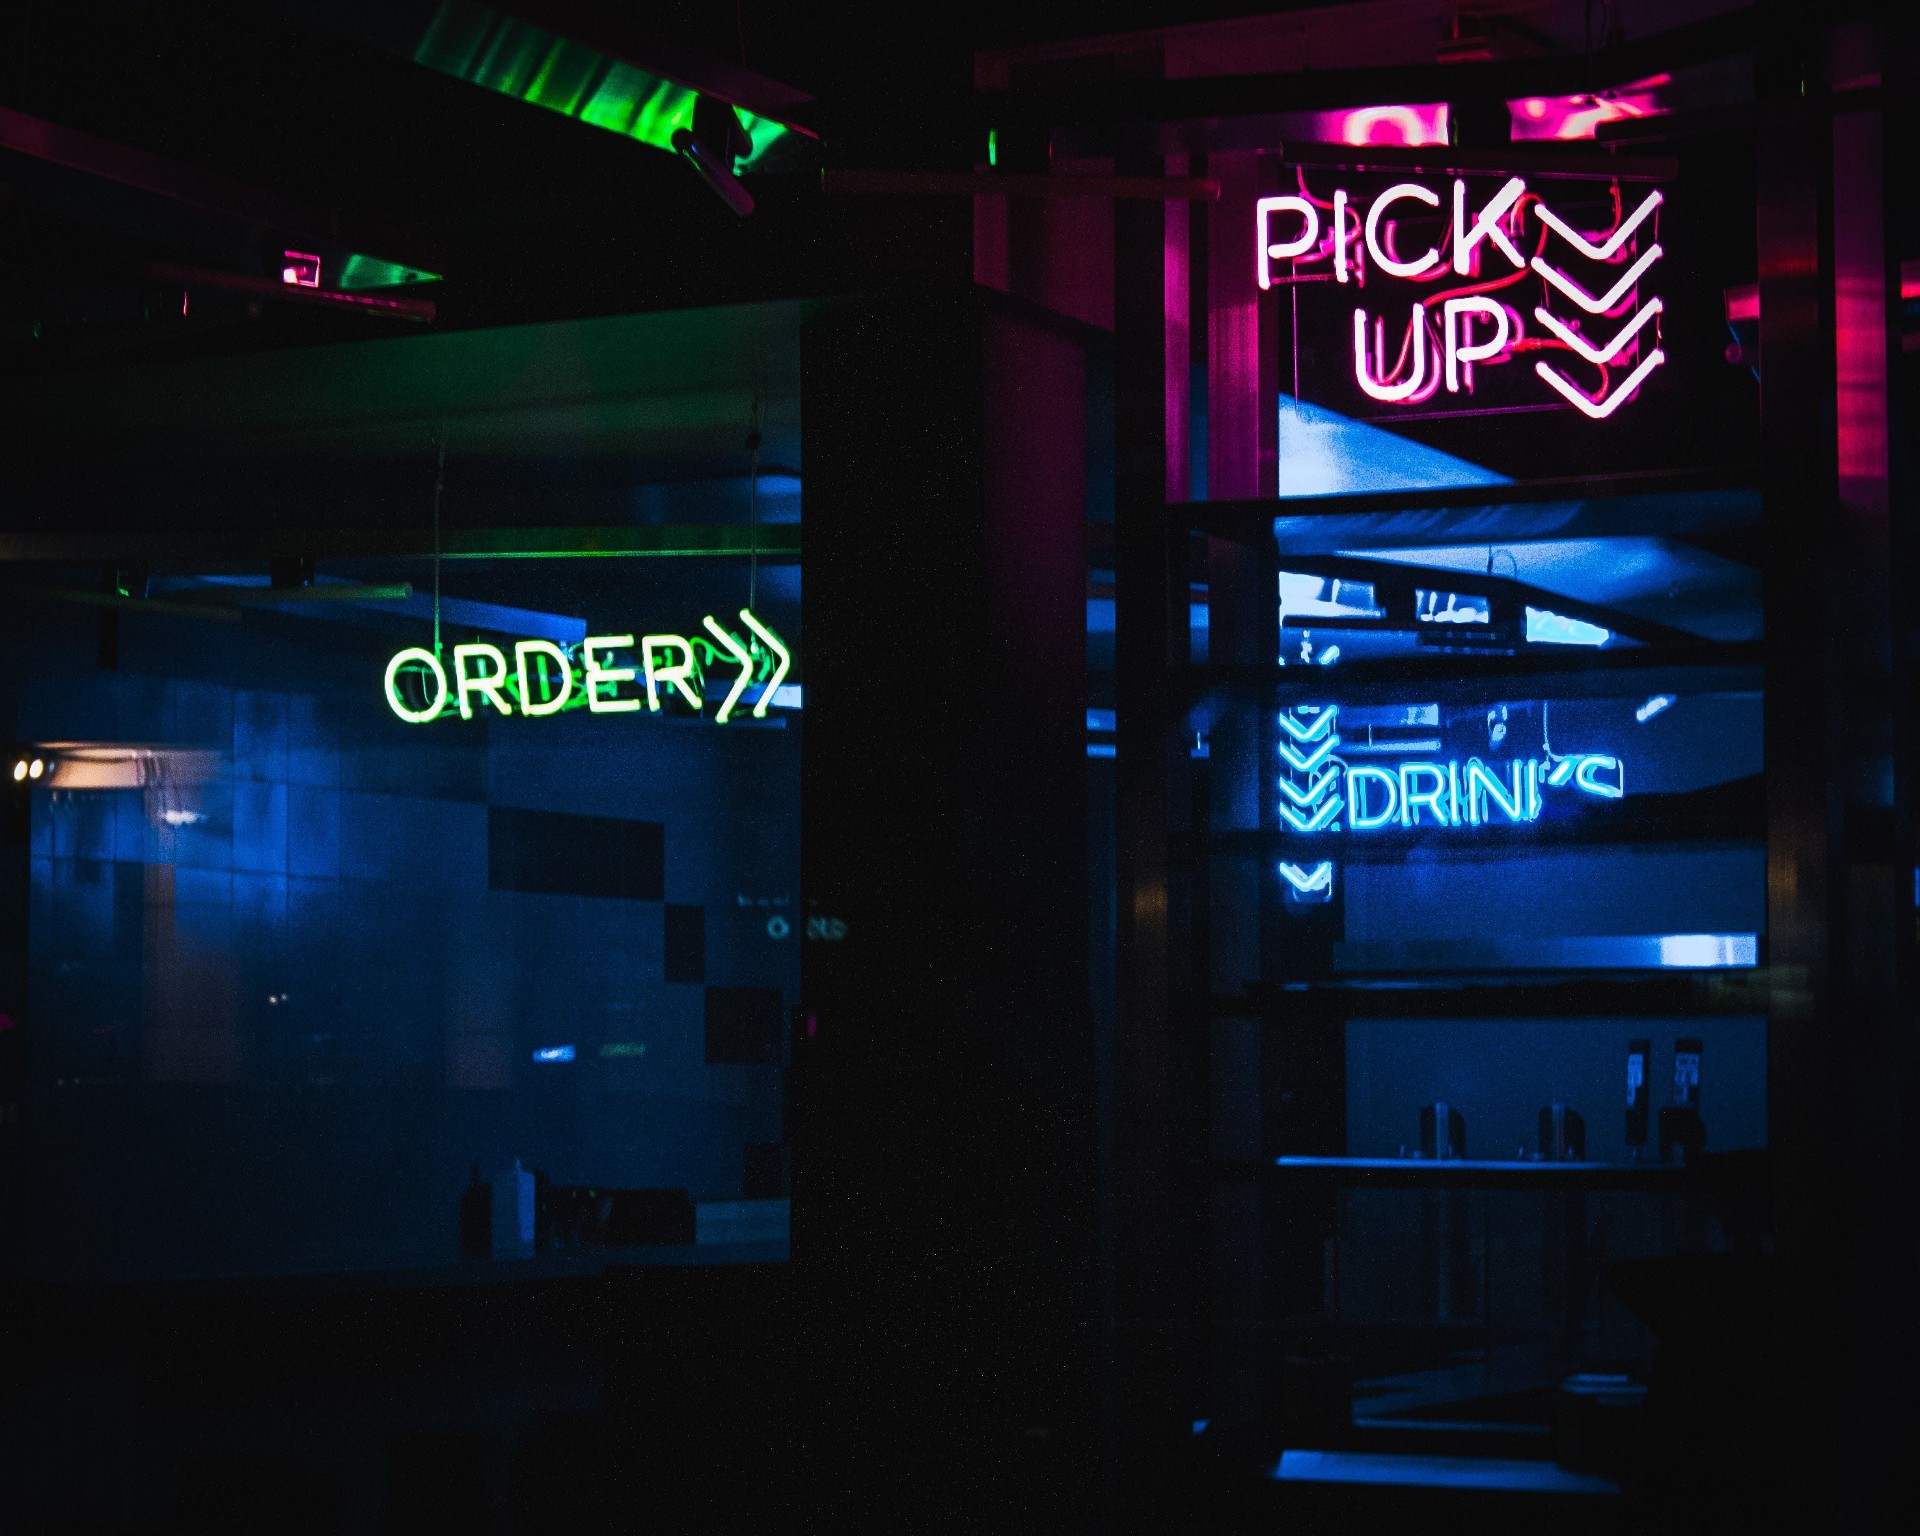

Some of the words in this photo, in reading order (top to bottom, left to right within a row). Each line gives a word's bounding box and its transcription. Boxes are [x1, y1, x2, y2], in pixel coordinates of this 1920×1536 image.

[1257, 177, 1527, 289] PICK
[1354, 297, 1510, 401] UP
[384, 634, 704, 723] ORDER
